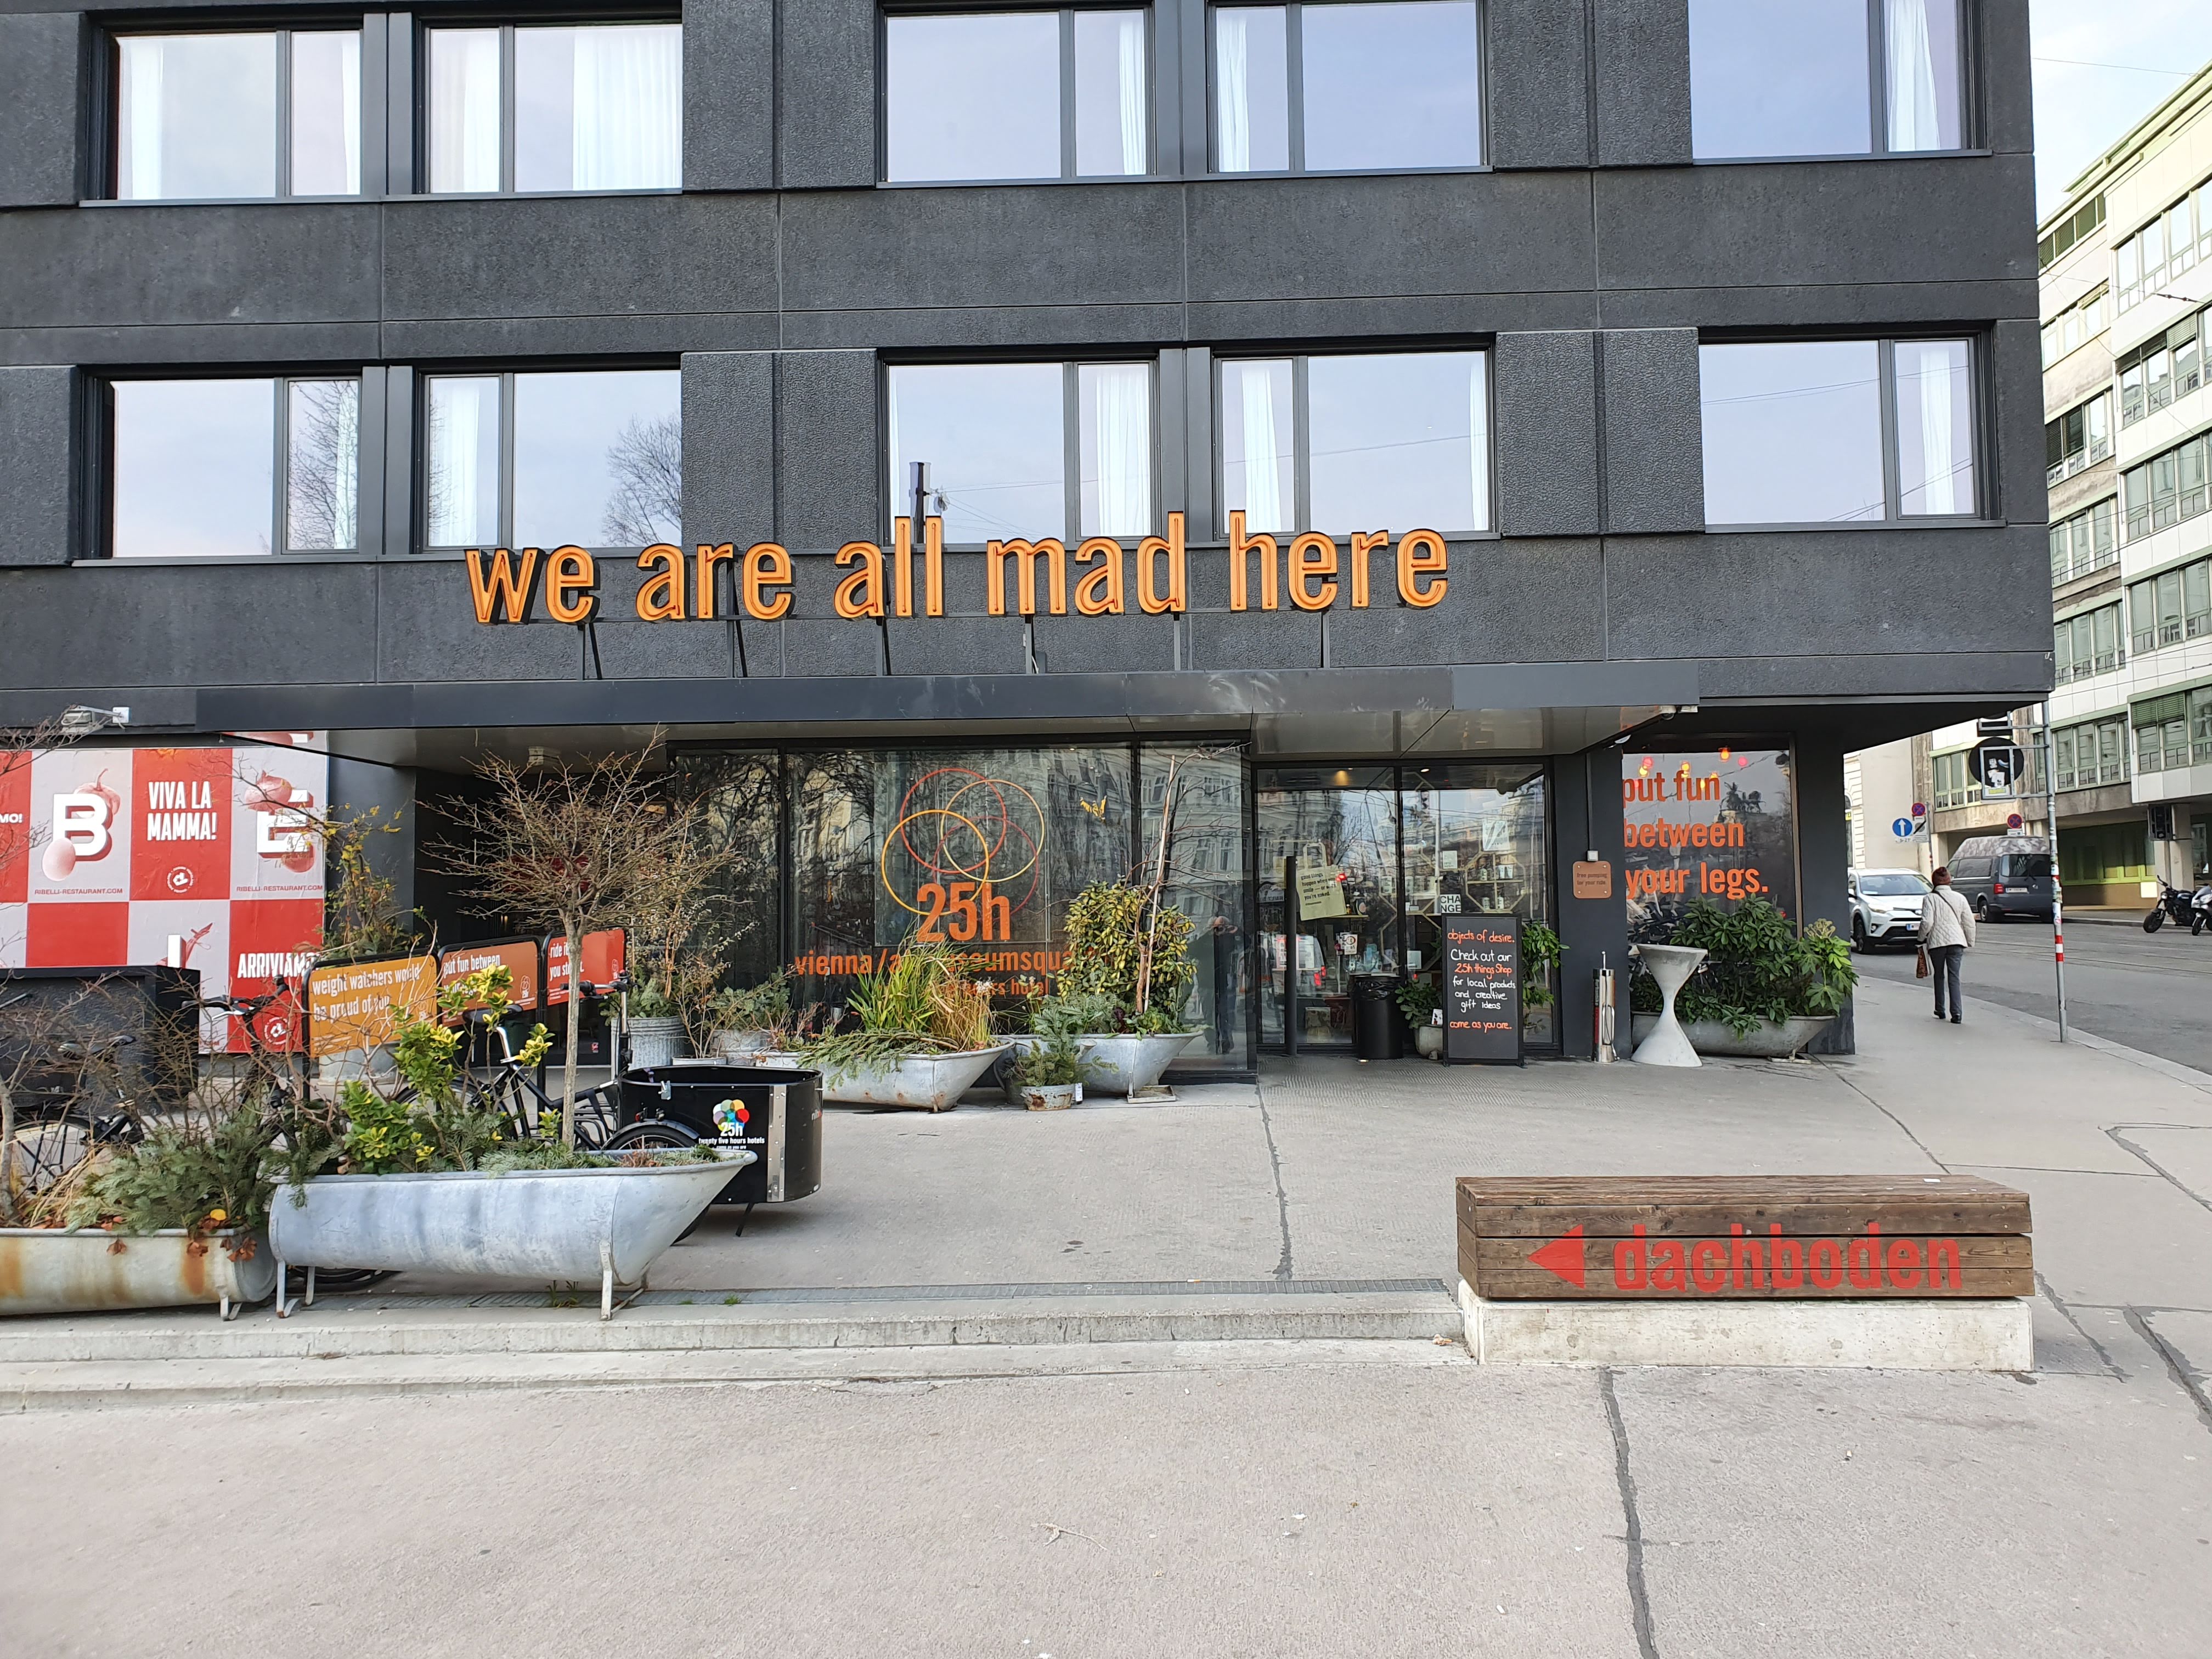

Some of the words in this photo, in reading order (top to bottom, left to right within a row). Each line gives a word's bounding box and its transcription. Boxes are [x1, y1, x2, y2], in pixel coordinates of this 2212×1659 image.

[466, 545, 600, 625] we
[636, 541, 797, 622] are
[834, 515, 948, 620] all
[987, 511, 1186, 616] mad
[1230, 509, 1448, 613] here
[149, 781, 186, 809] VIVA
[191, 781, 212, 809] LA
[1623, 772, 1666, 809] put
[1673, 770, 1720, 801] fun
[147, 812, 217, 841] MAMMA!
[1623, 817, 1745, 848] between
[1625, 868, 1690, 900] your
[1701, 862, 1769, 900] legs.
[917, 882, 1011, 943] 25h
[1447, 928, 1475, 944] objects
[1476, 929, 1487, 943] of
[1489, 930, 1515, 943] desire.
[550, 943, 562, 958] ride
[1451, 949, 1479, 961] Check
[1481, 950, 1494, 962] out
[443, 958, 456, 979] put
[457, 956, 469, 973] fun
[470, 954, 500, 970] between
[550, 965, 561, 981] you
[1454, 963, 1472, 973] 25h
[1474, 963, 1494, 979] things
[1496, 963, 1512, 977] Shop
[312, 973, 348, 997] weight
[349, 968, 393, 991] watchers
[394, 962, 420, 983] would
[1453, 975, 1464, 987] for
[1467, 977, 1487, 988] local
[1489, 979, 1516, 993] products
[1454, 990, 1470, 998] and
[1475, 990, 1508, 1000] creative
[1460, 999, 1476, 1013] gift
[1481, 1001, 1501, 1009] ideas
[313, 1002, 328, 1022] be
[330, 996, 359, 1024] proud
[362, 994, 371, 1014] of
[1484, 1022, 1496, 1033] you
[720, 1122, 743, 1137] 25h
[1613, 1223, 1963, 1293] dachboden
